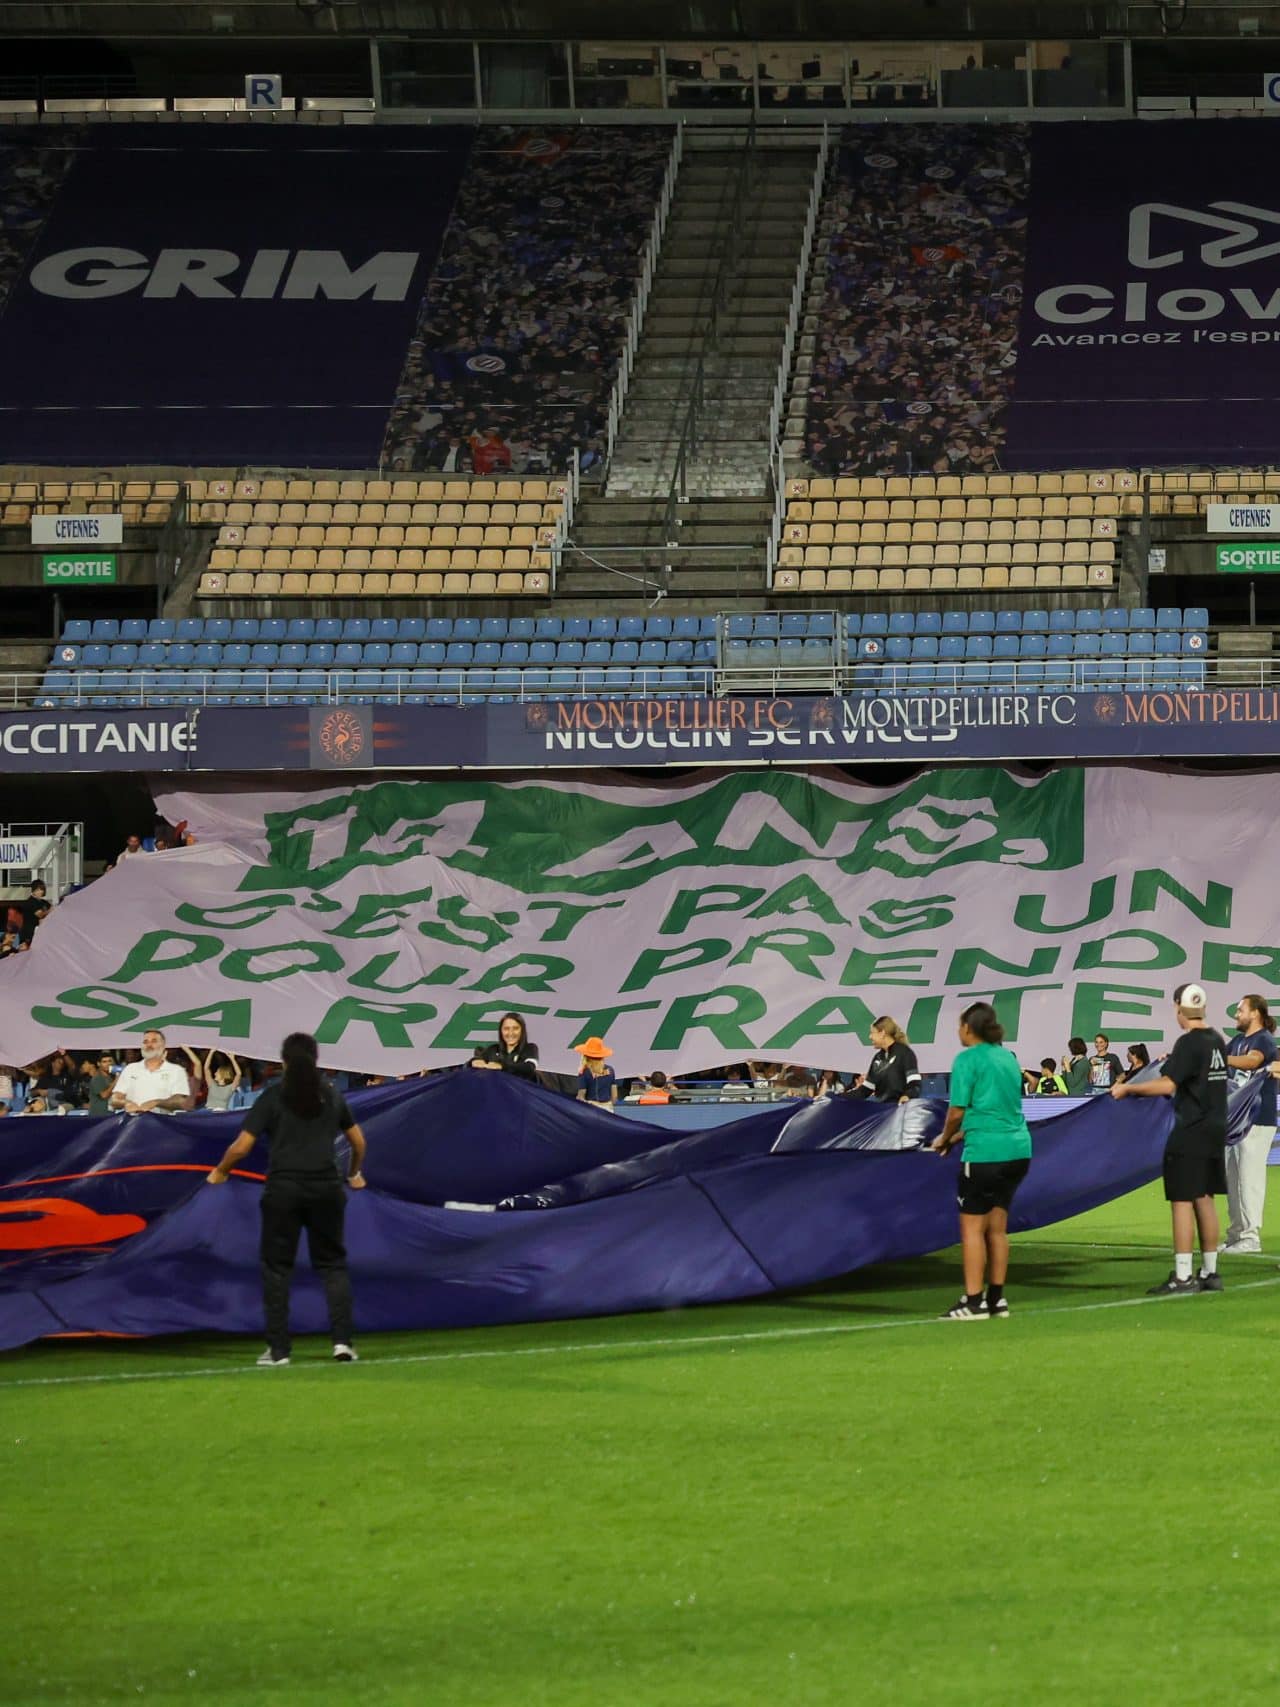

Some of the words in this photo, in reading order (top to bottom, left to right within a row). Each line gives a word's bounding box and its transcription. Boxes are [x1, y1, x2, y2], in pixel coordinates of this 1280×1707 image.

[249, 79, 275, 104] R
[30, 246, 419, 301] GRIM
[1031, 330, 1182, 348] Avancez
[56, 519, 99, 538] CEVENNES
[1229, 508, 1271, 527] CEVENNES
[47, 561, 111, 577] SORTIE
[1219, 550, 1280, 566] SORTIE
[558, 699, 746, 730] MONTPELLIER
[753, 699, 793, 730] FC
[842, 696, 1030, 727] MONTPELLIER
[1037, 695, 1077, 725] FC
[0, 722, 198, 754] CCITANIE
[658, 874, 956, 939] PAS
[1013, 868, 1233, 934] UN
[100, 930, 575, 993] POUR
[31, 986, 252, 1038] SA
[314, 983, 1165, 1050] RETRAITE
